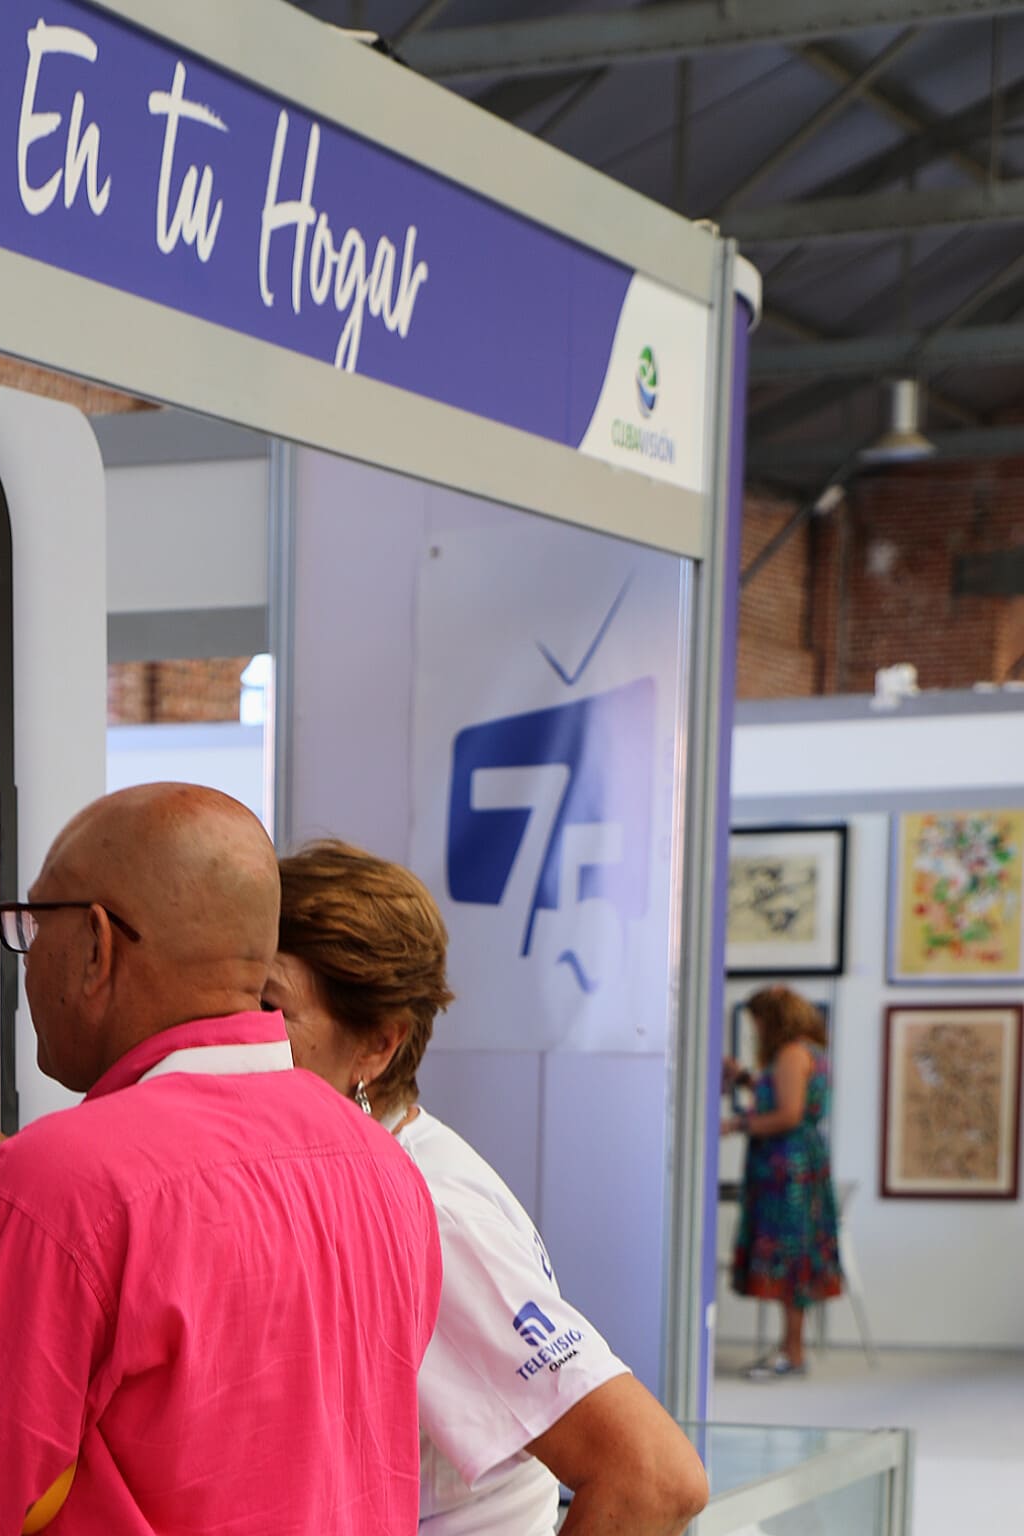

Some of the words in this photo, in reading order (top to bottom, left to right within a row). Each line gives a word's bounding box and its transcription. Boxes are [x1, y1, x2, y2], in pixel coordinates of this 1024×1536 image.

[18, 18, 110, 215] En
[149, 61, 228, 262] tu
[260, 110, 428, 373] Hogar
